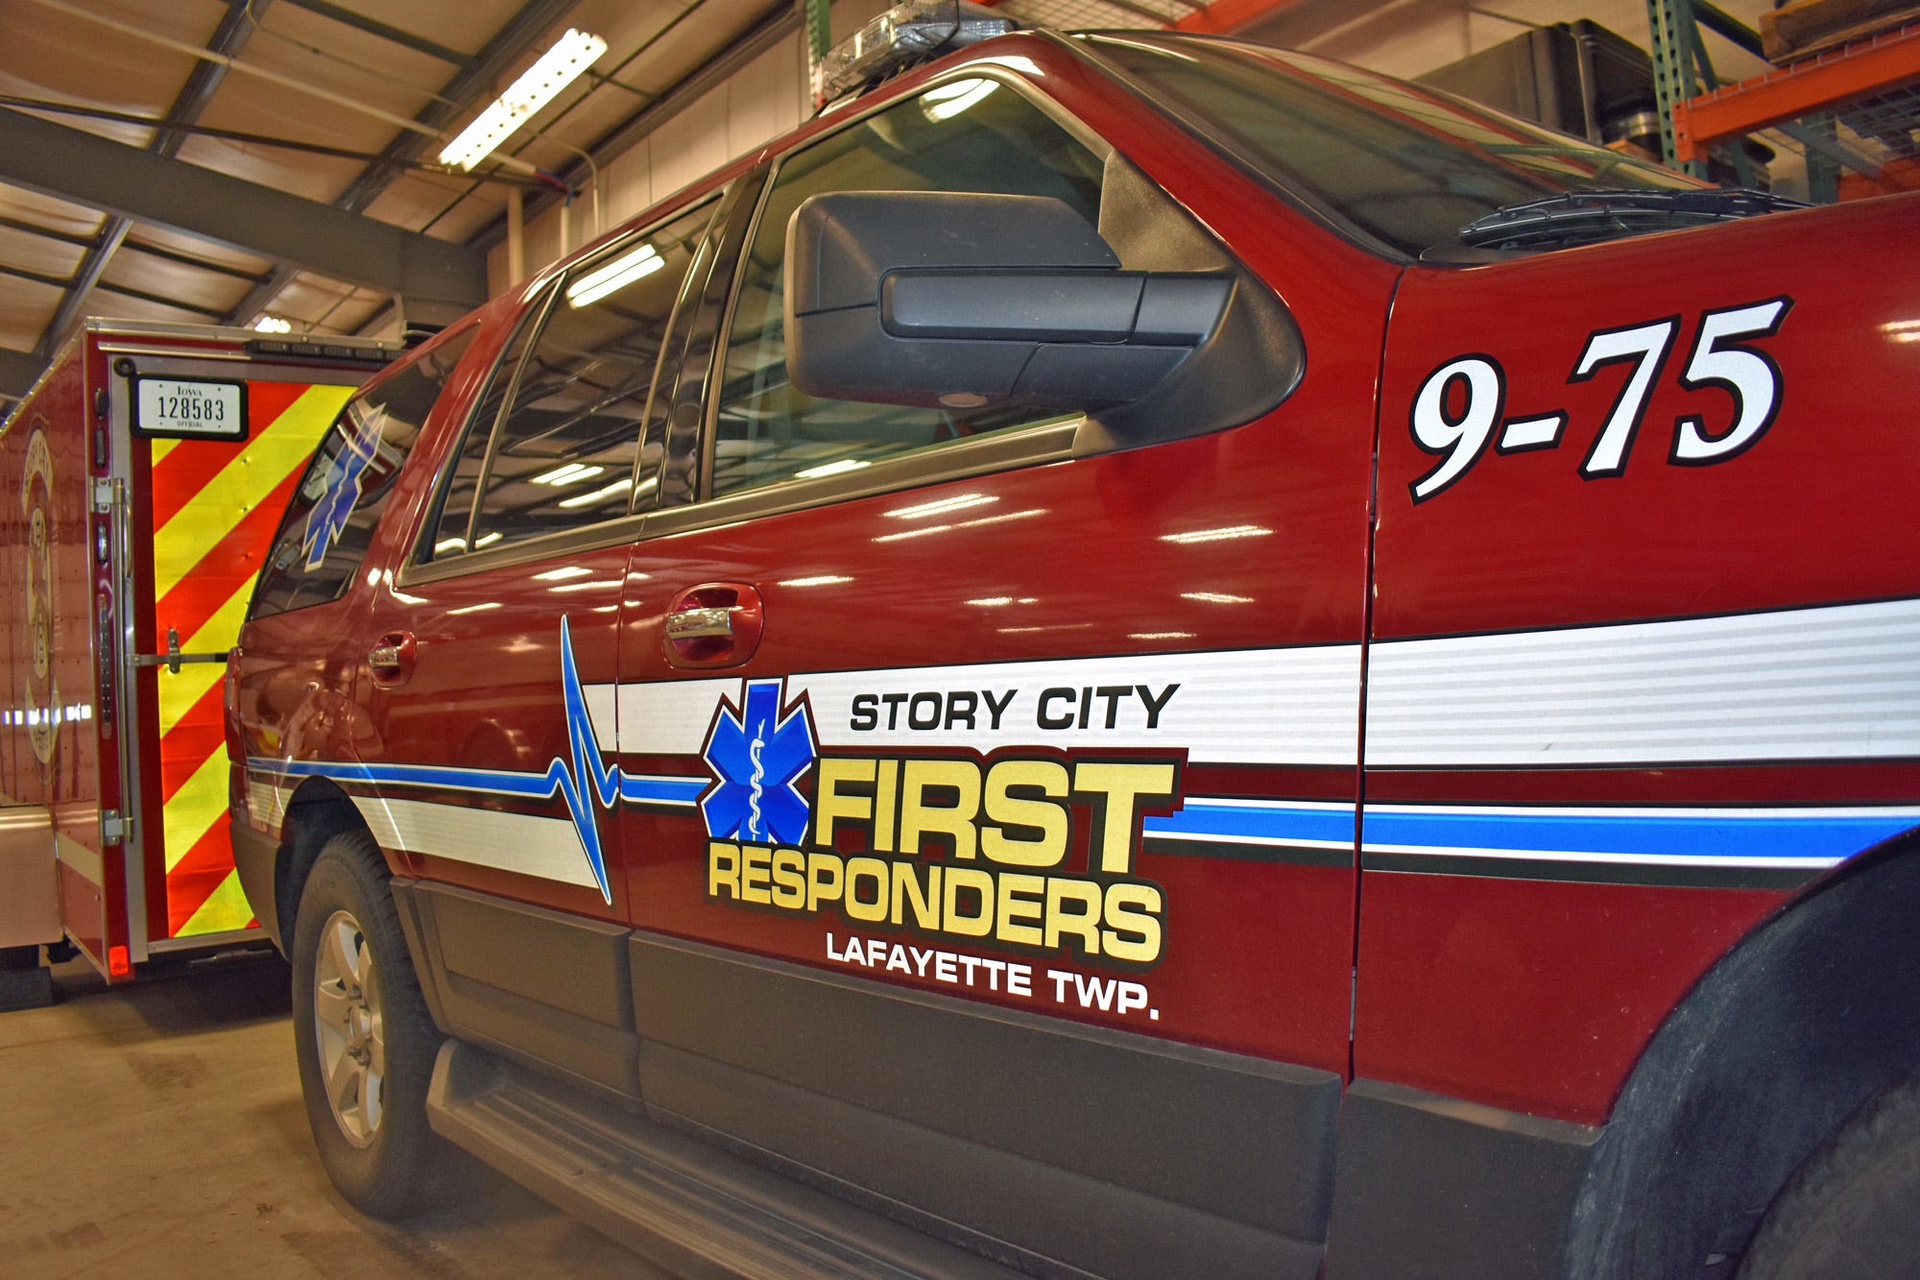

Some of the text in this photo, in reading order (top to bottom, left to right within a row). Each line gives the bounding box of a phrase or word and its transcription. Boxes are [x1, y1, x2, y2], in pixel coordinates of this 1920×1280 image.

[158, 396, 225, 421] 128583
[176, 420, 204, 429] OFFICIAL
[1407, 294, 1796, 506] 9-75
[850, 683, 1181, 730] STORY CITY
[815, 758, 1175, 874] FIRST
[709, 842, 1163, 963] RESPONDERS
[826, 932, 1160, 1021] LAFAYETTE TWP.
